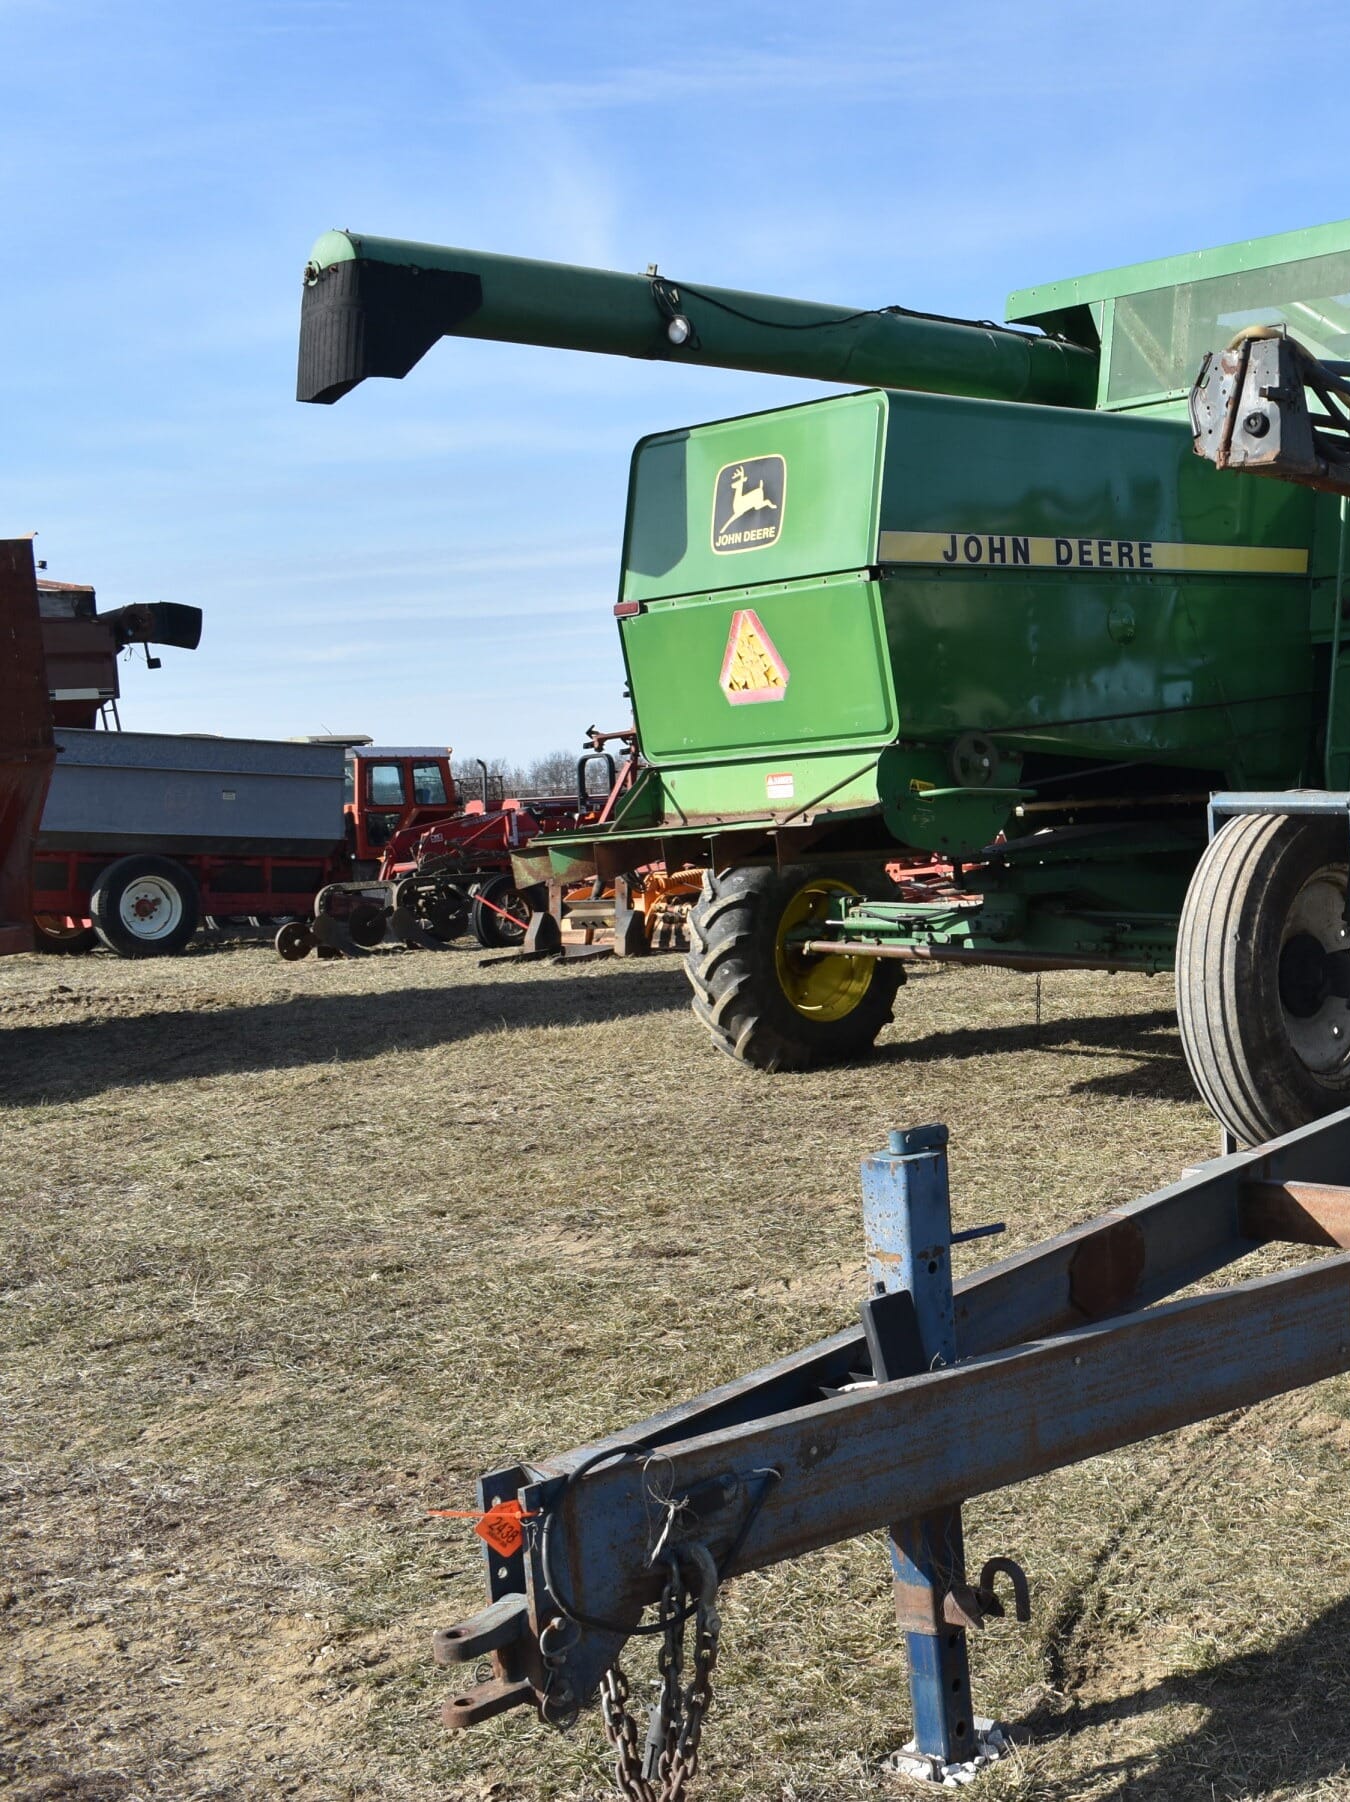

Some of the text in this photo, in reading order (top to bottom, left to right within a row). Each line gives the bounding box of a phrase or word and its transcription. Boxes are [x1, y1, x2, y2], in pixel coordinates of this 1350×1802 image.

[715, 526, 776, 547] JOHN DEERE
[943, 535, 1153, 568] JOHN DEERE
